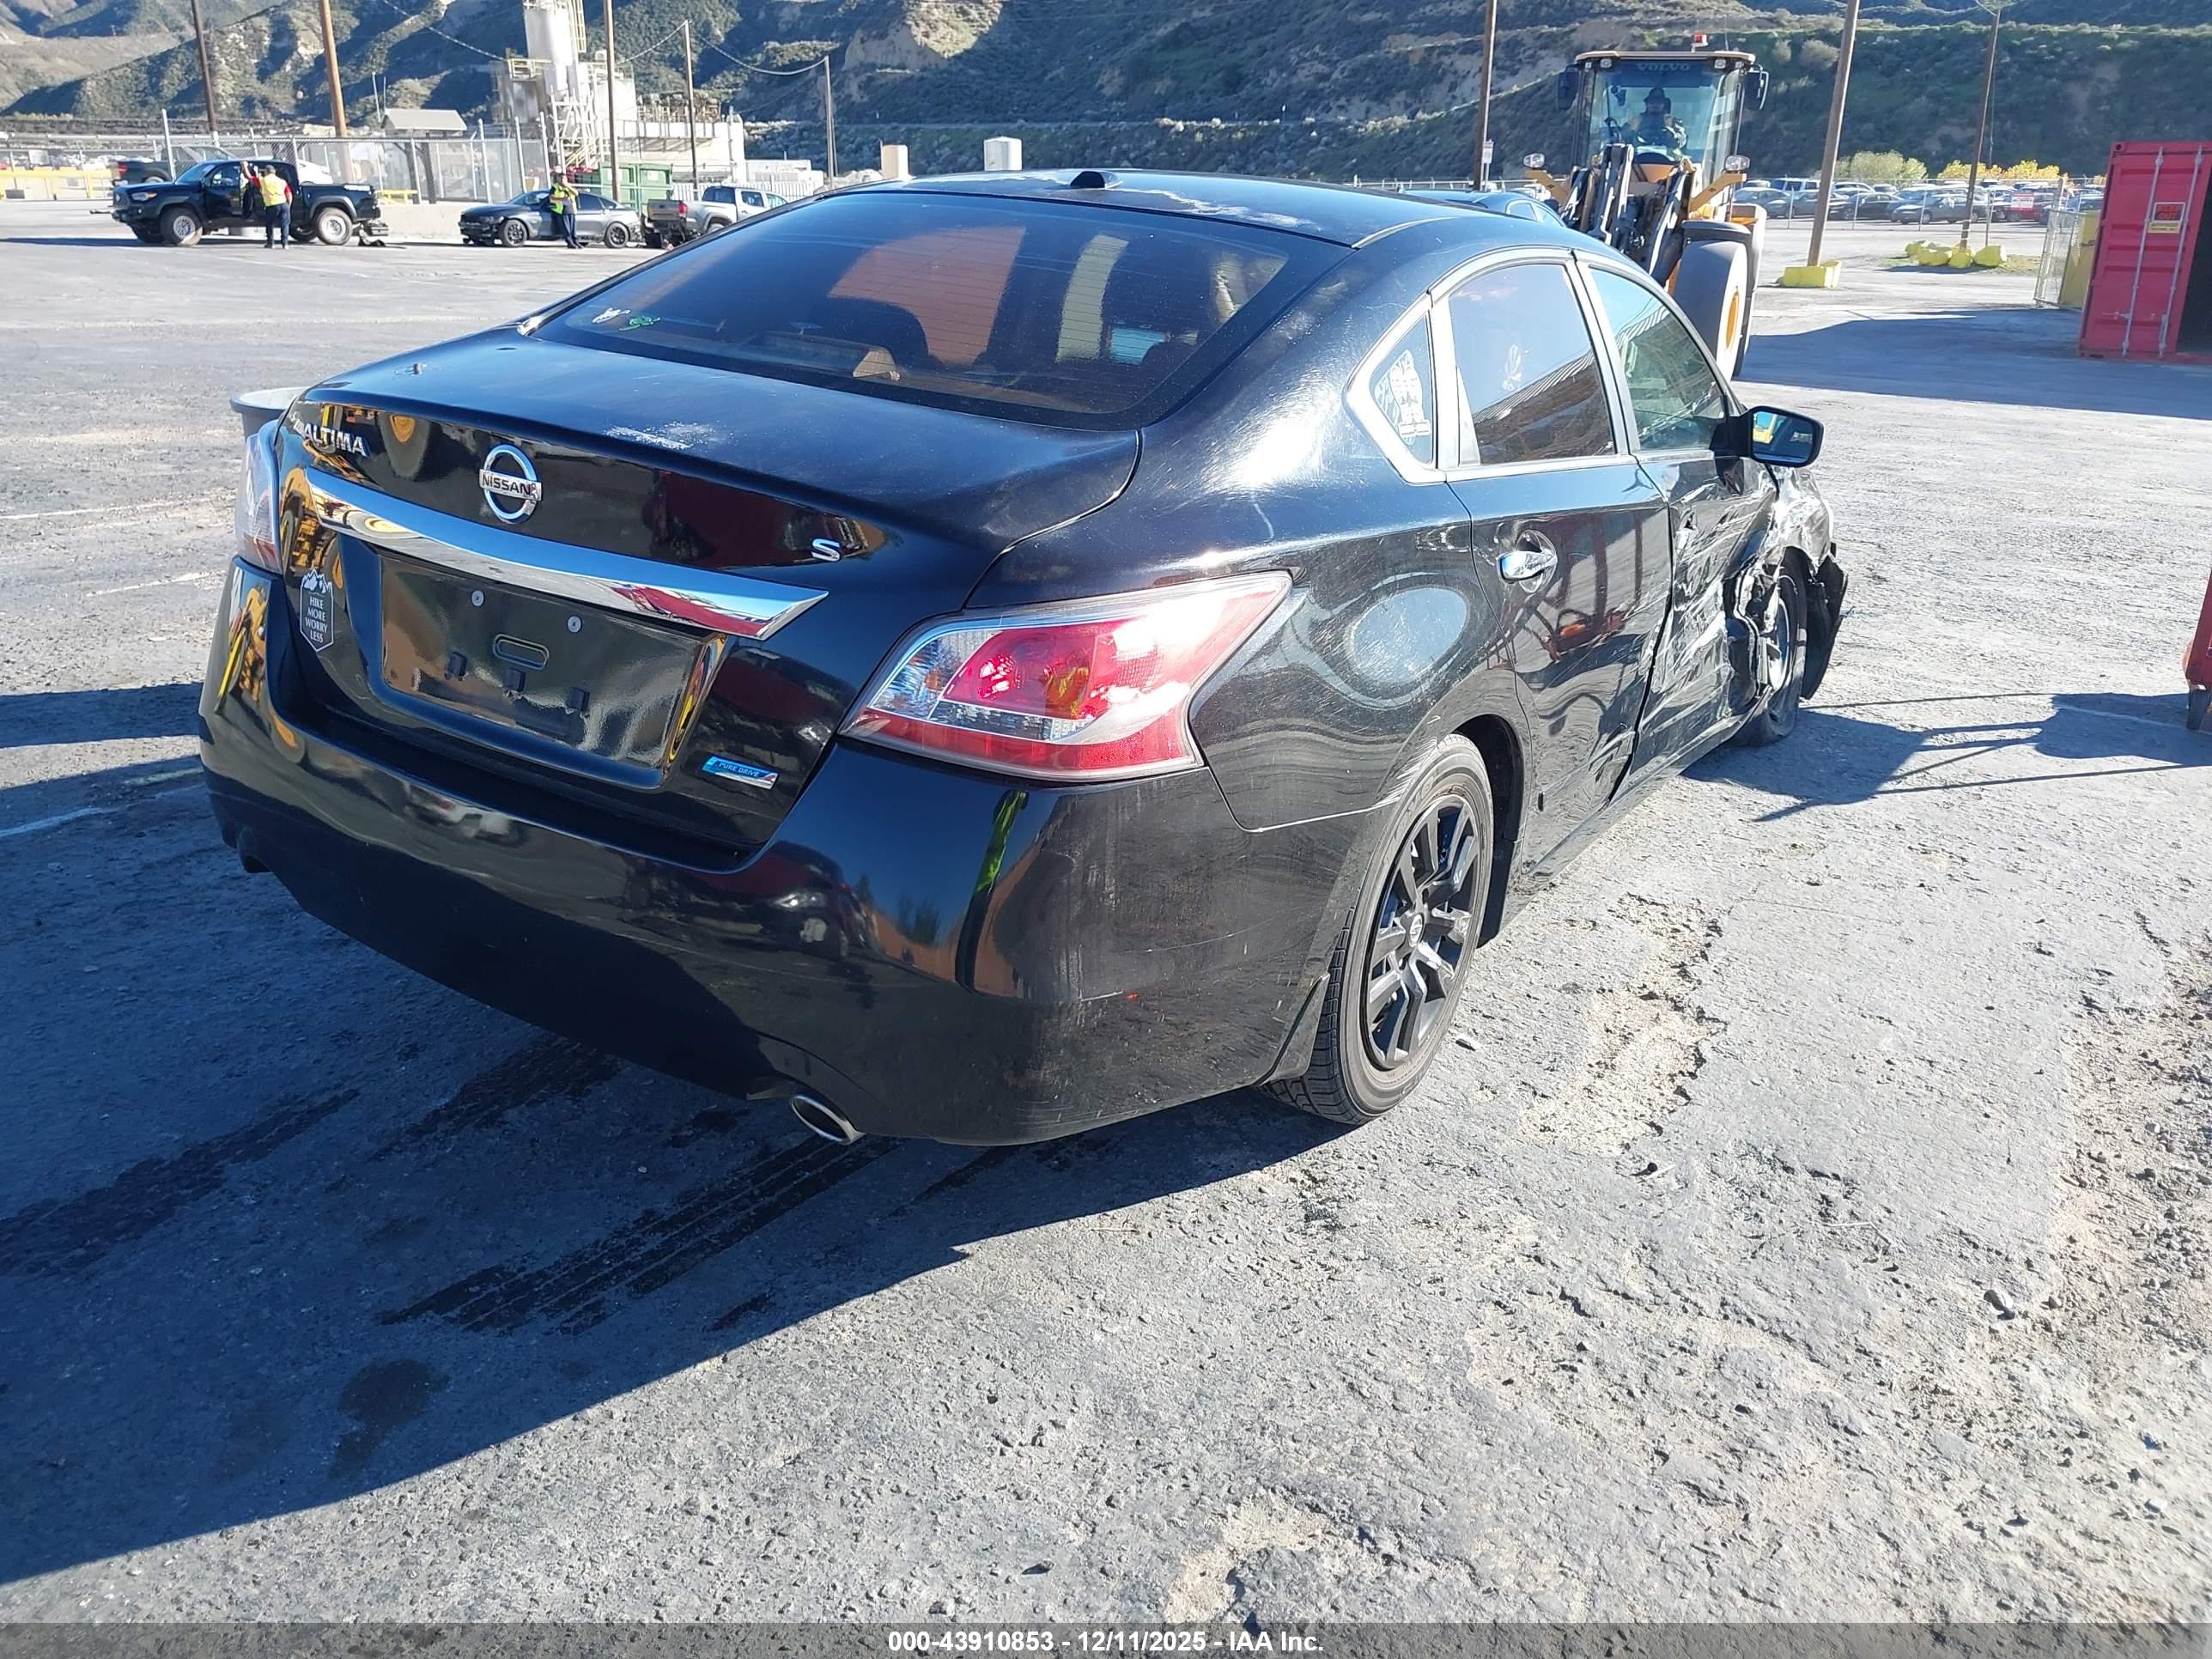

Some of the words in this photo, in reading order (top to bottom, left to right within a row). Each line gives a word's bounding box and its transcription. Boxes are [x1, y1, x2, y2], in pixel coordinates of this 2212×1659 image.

[1636, 63, 1690, 71] VOLVO
[305, 423, 368, 458] ALTIMA
[483, 473, 531, 495] NISSAN
[811, 538, 840, 561] S
[309, 596, 324, 609] HIKE
[307, 606, 325, 621] MORE
[305, 617, 327, 633] WORRY
[310, 630, 324, 643] LESS
[719, 762, 738, 772] PURE
[738, 767, 760, 777] DRIVE
